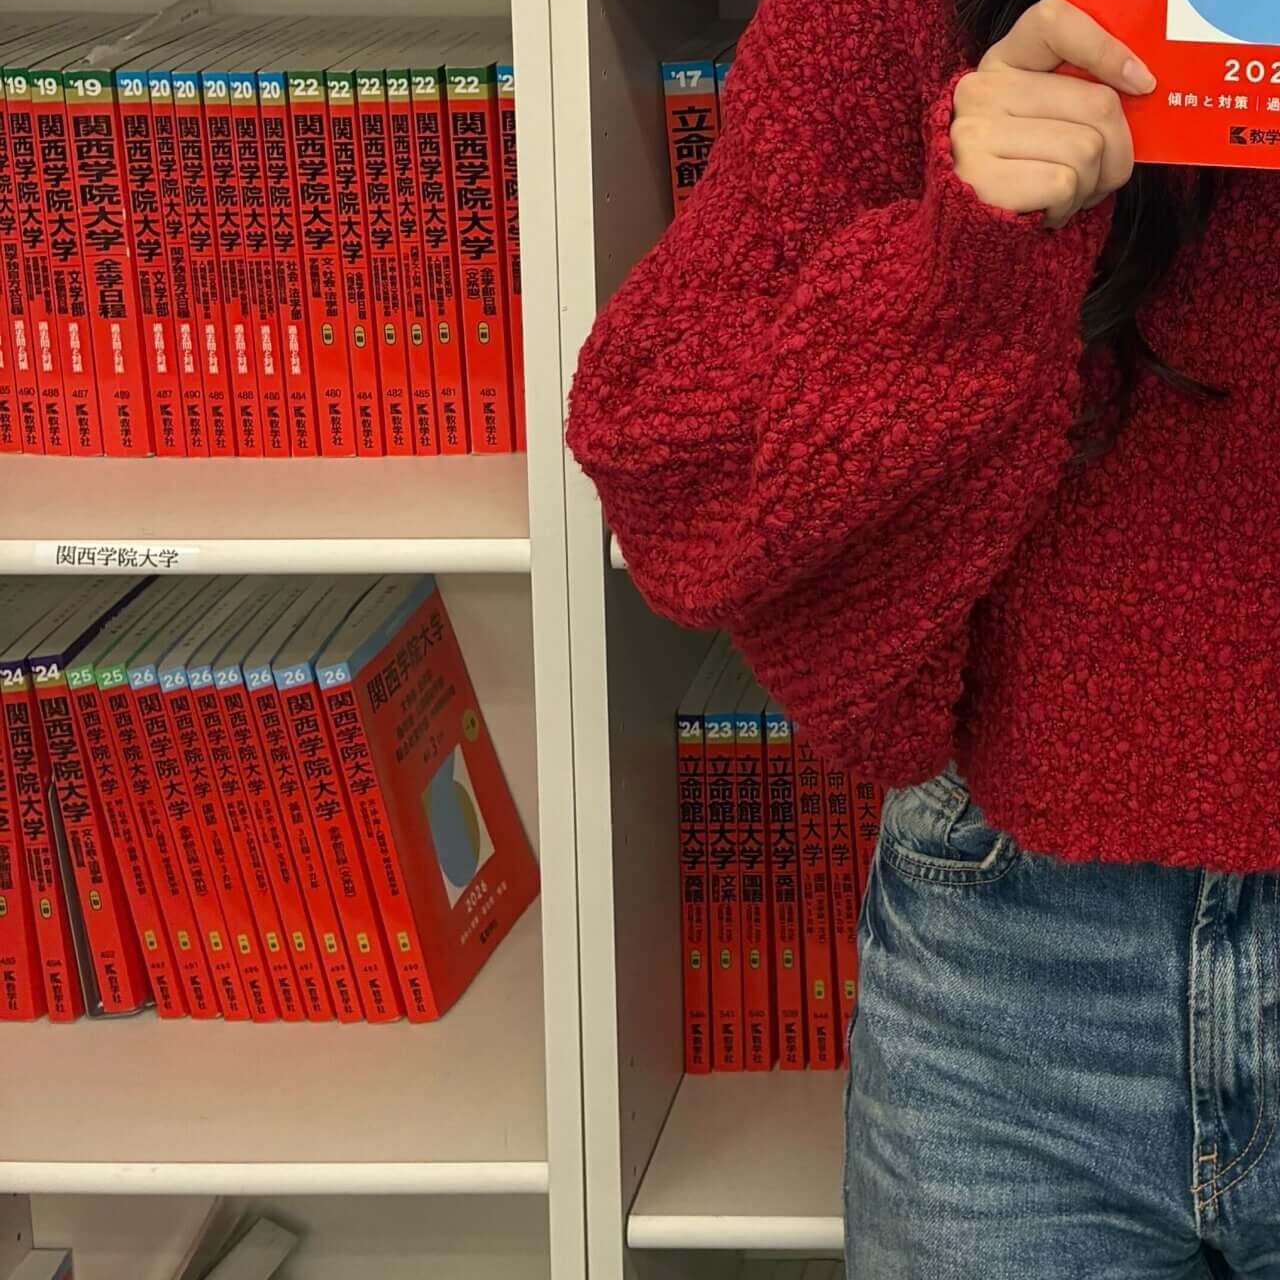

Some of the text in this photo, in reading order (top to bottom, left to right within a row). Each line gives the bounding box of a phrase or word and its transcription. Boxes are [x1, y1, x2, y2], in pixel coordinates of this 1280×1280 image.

[4, 76, 27, 94] '19
[34, 78, 57, 95] '19
[69, 79, 101, 96] '19
[120, 79, 142, 96] '20
[204, 80, 226, 97] '20
[230, 81, 252, 99] '20
[290, 79, 318, 96] '22
[328, 81, 350, 98] '22
[357, 78, 381, 96] '22
[412, 77, 436, 93] '22
[450, 76, 480, 93] '22
[671, 71, 702, 88] '17
[72, 115, 127, 250] 関西学院大学
[124, 115, 163, 263] 関西学院大学
[294, 115, 334, 250] 関西学院大学
[94, 259, 127, 319] 全学日程
[56, 545, 179, 569] 関西学院大学
[40, 696, 92, 823] 関西学院大学
[137, 692, 190, 821] 関西学院大学
[287, 692, 342, 821] 関西学院大学
[6, 703, 45, 841] 関西学院大学
[679, 755, 705, 870] 立命館大学
[709, 755, 737, 870] 立命館大学
[737, 755, 763, 870] 立命館大学
[768, 755, 797, 870] 立命館大学
